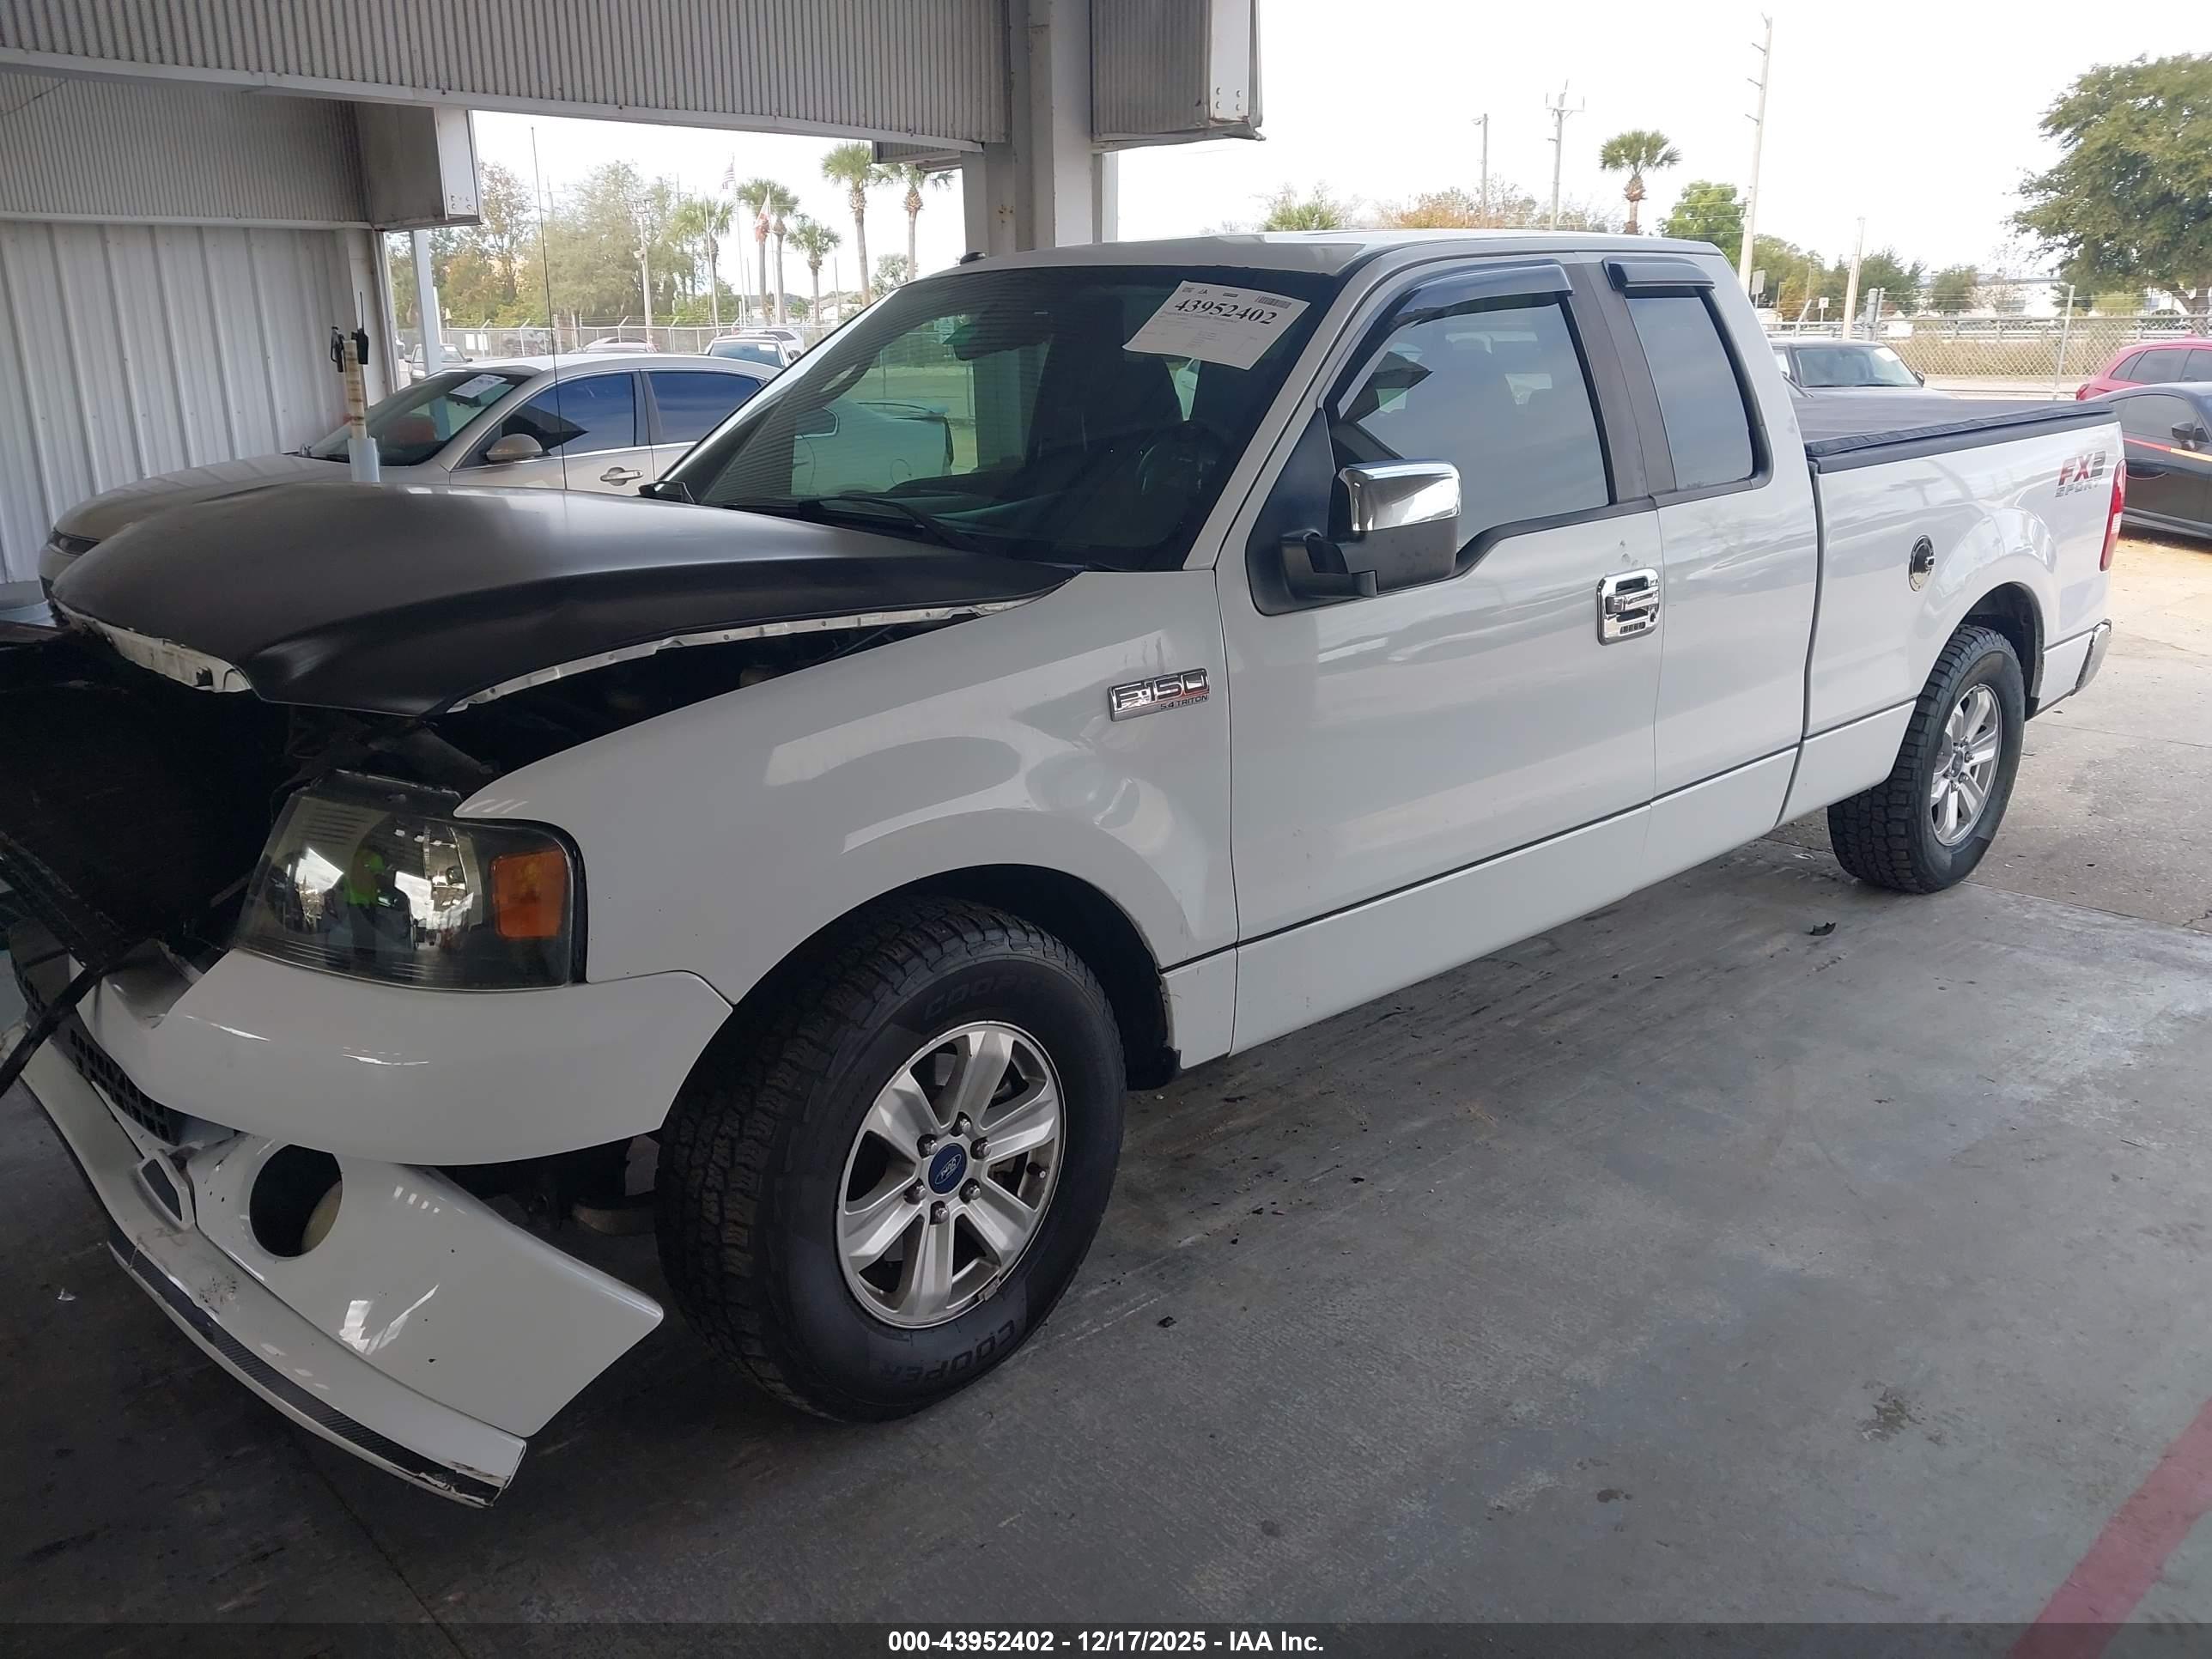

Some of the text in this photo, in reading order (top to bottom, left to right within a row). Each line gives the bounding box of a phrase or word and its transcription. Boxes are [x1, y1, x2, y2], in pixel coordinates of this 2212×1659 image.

[1174, 298, 1278, 325] 43952402
[2057, 450, 2106, 487] FX2
[2055, 477, 2102, 498] SPORT
[1177, 694, 1208, 708] TRITON
